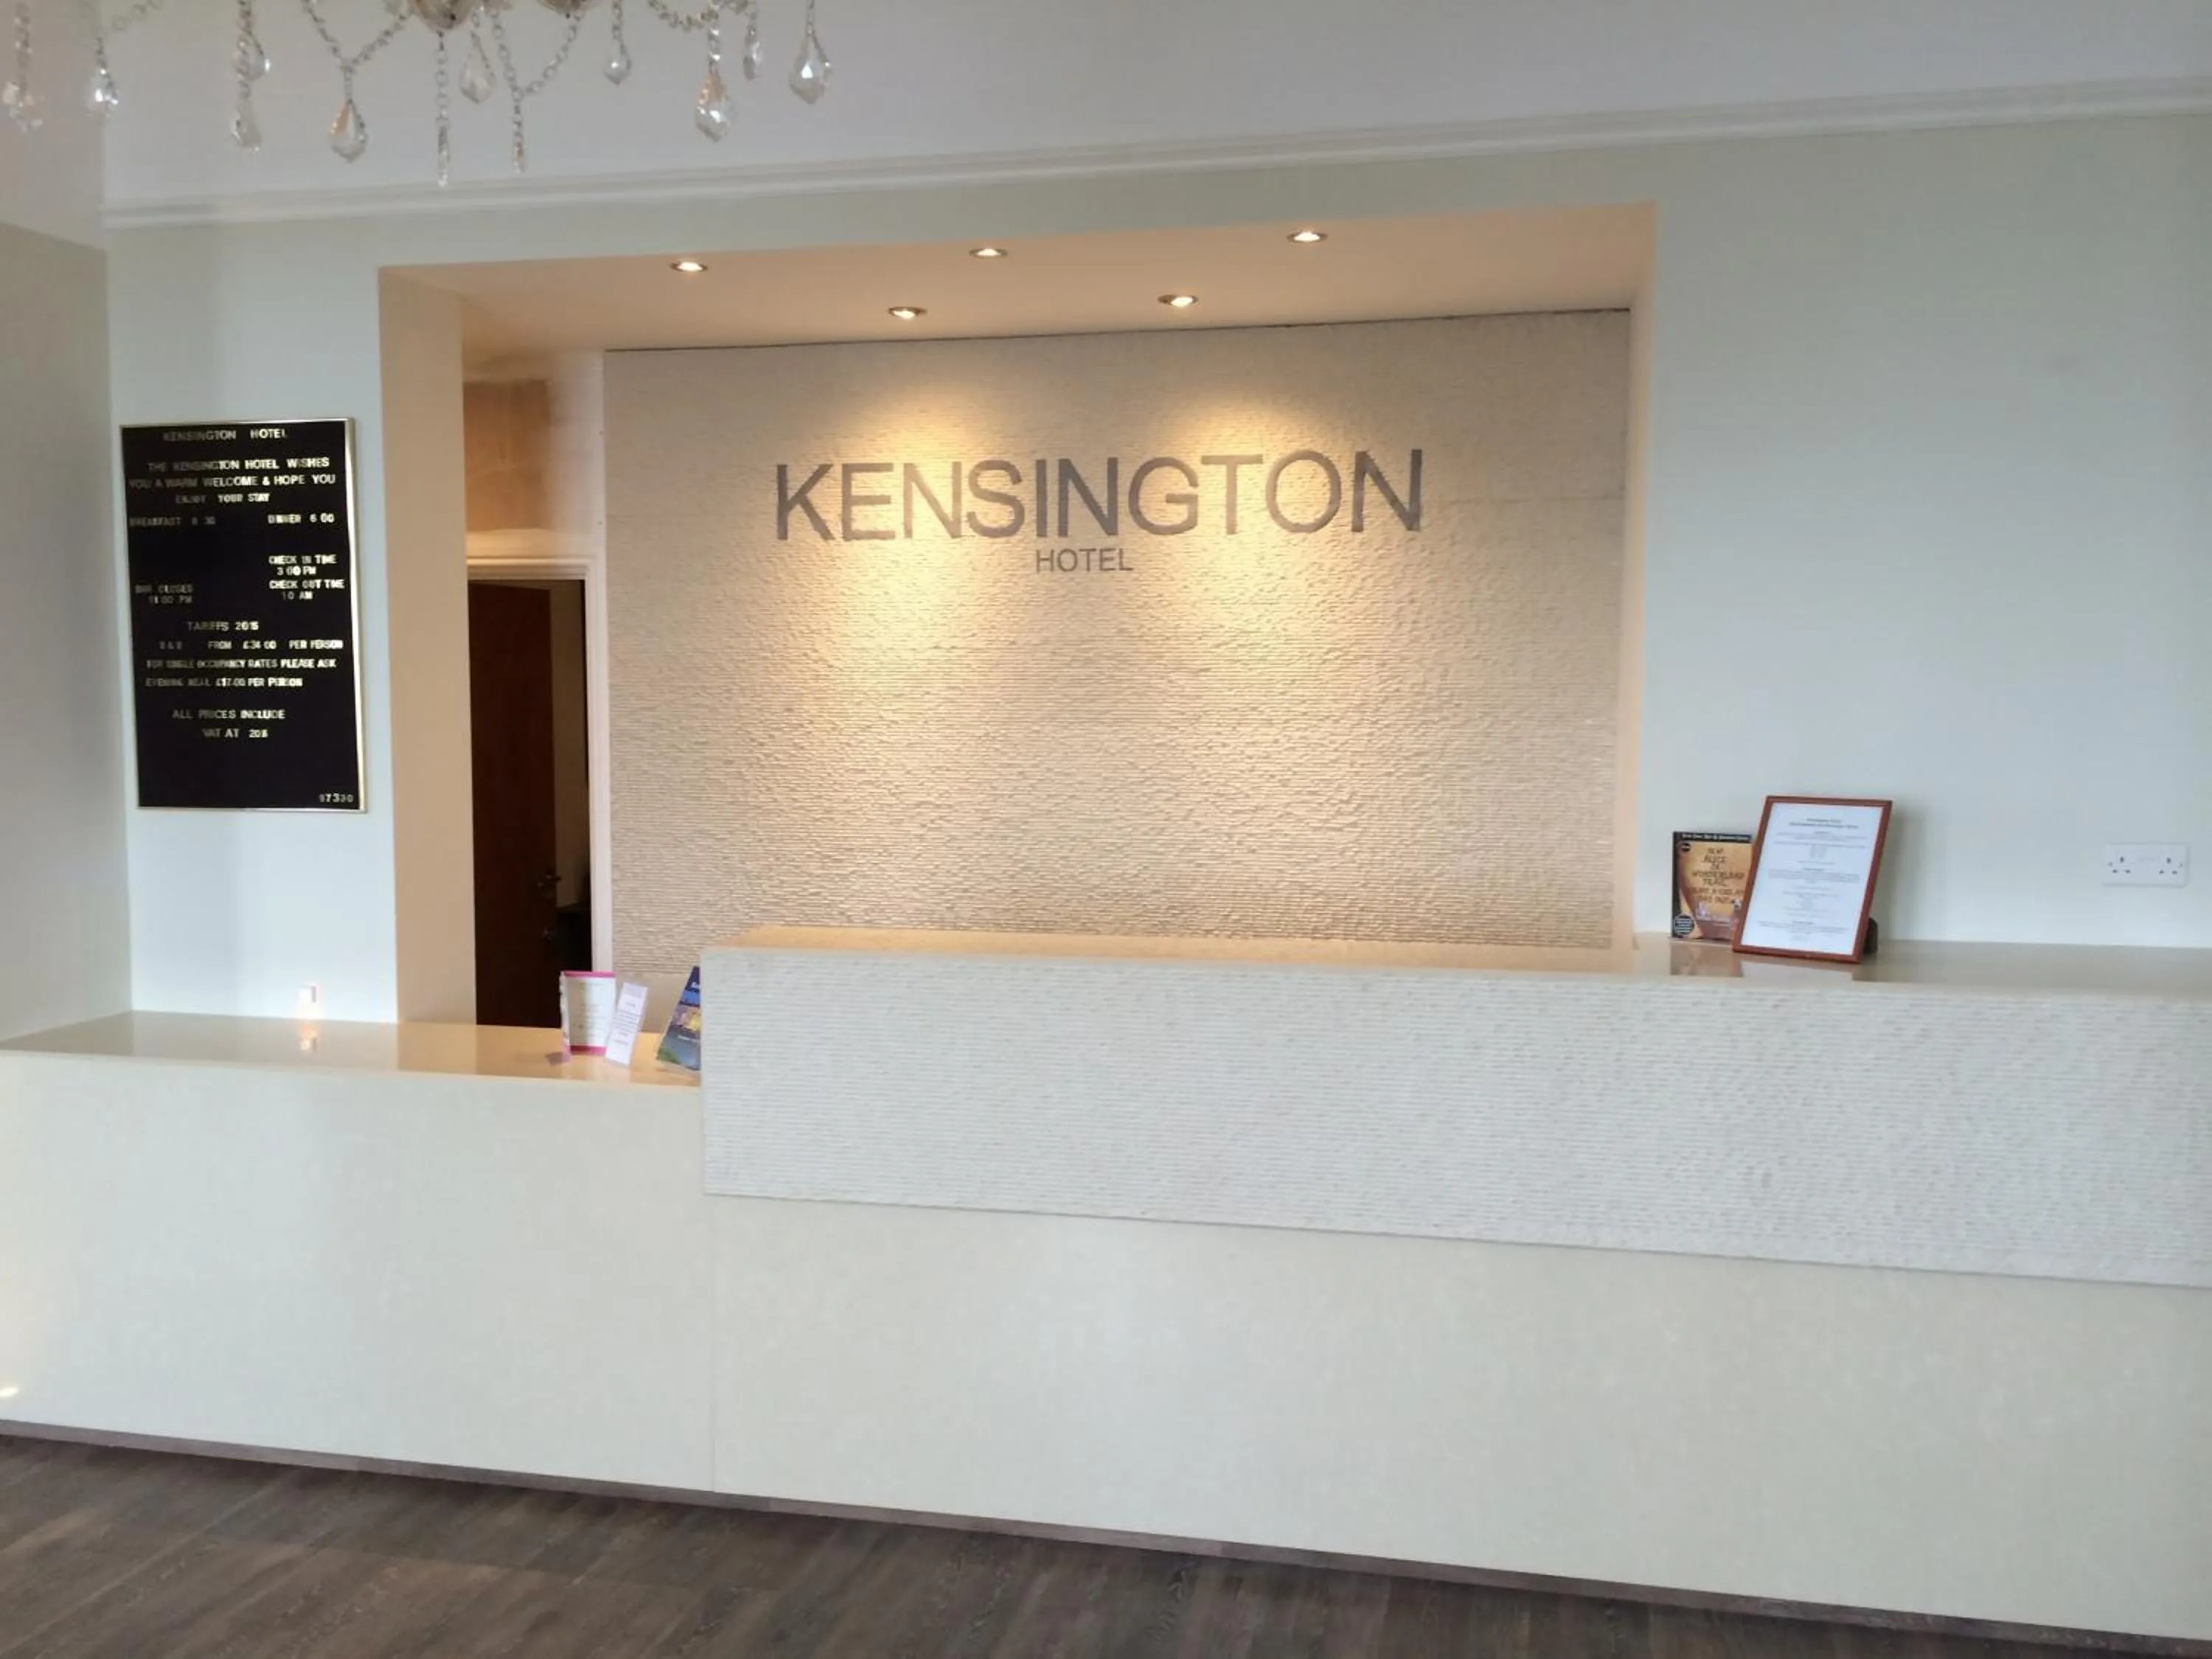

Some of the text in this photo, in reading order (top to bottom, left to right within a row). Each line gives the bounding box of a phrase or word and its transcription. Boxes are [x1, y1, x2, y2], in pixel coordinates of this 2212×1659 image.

[163, 428, 288, 442] KENSINGTON HOTEL
[173, 459, 240, 472] KENSINGTON
[244, 459, 279, 470] HOTEL
[286, 457, 330, 469] WISHES
[203, 476, 260, 488] WELCOME
[262, 476, 271, 487] &
[274, 475, 306, 487] HOPE
[312, 473, 336, 484] YOU
[218, 494, 243, 504] YOUR
[248, 493, 271, 503] STAY
[776, 448, 1424, 540] KENSINGTON
[268, 514, 302, 524] DINNER
[268, 554, 337, 565] CHECK IN TIME
[1035, 548, 1135, 573] HOTEL
[303, 566, 316, 576] PM
[269, 579, 345, 590] CHECK OUT TIME
[299, 591, 313, 600] AM
[208, 640, 232, 650] FROM
[289, 640, 307, 650] PER
[310, 639, 344, 650] PERSON
[248, 658, 279, 669] RATES
[280, 658, 316, 669] PLEASE
[317, 658, 337, 669] ASK
[248, 677, 265, 687] PER
[268, 677, 304, 687] PERSON
[173, 709, 287, 720] ALL PRICES INCLUDE
[201, 728, 223, 738] VAT
[224, 728, 240, 738] AT
